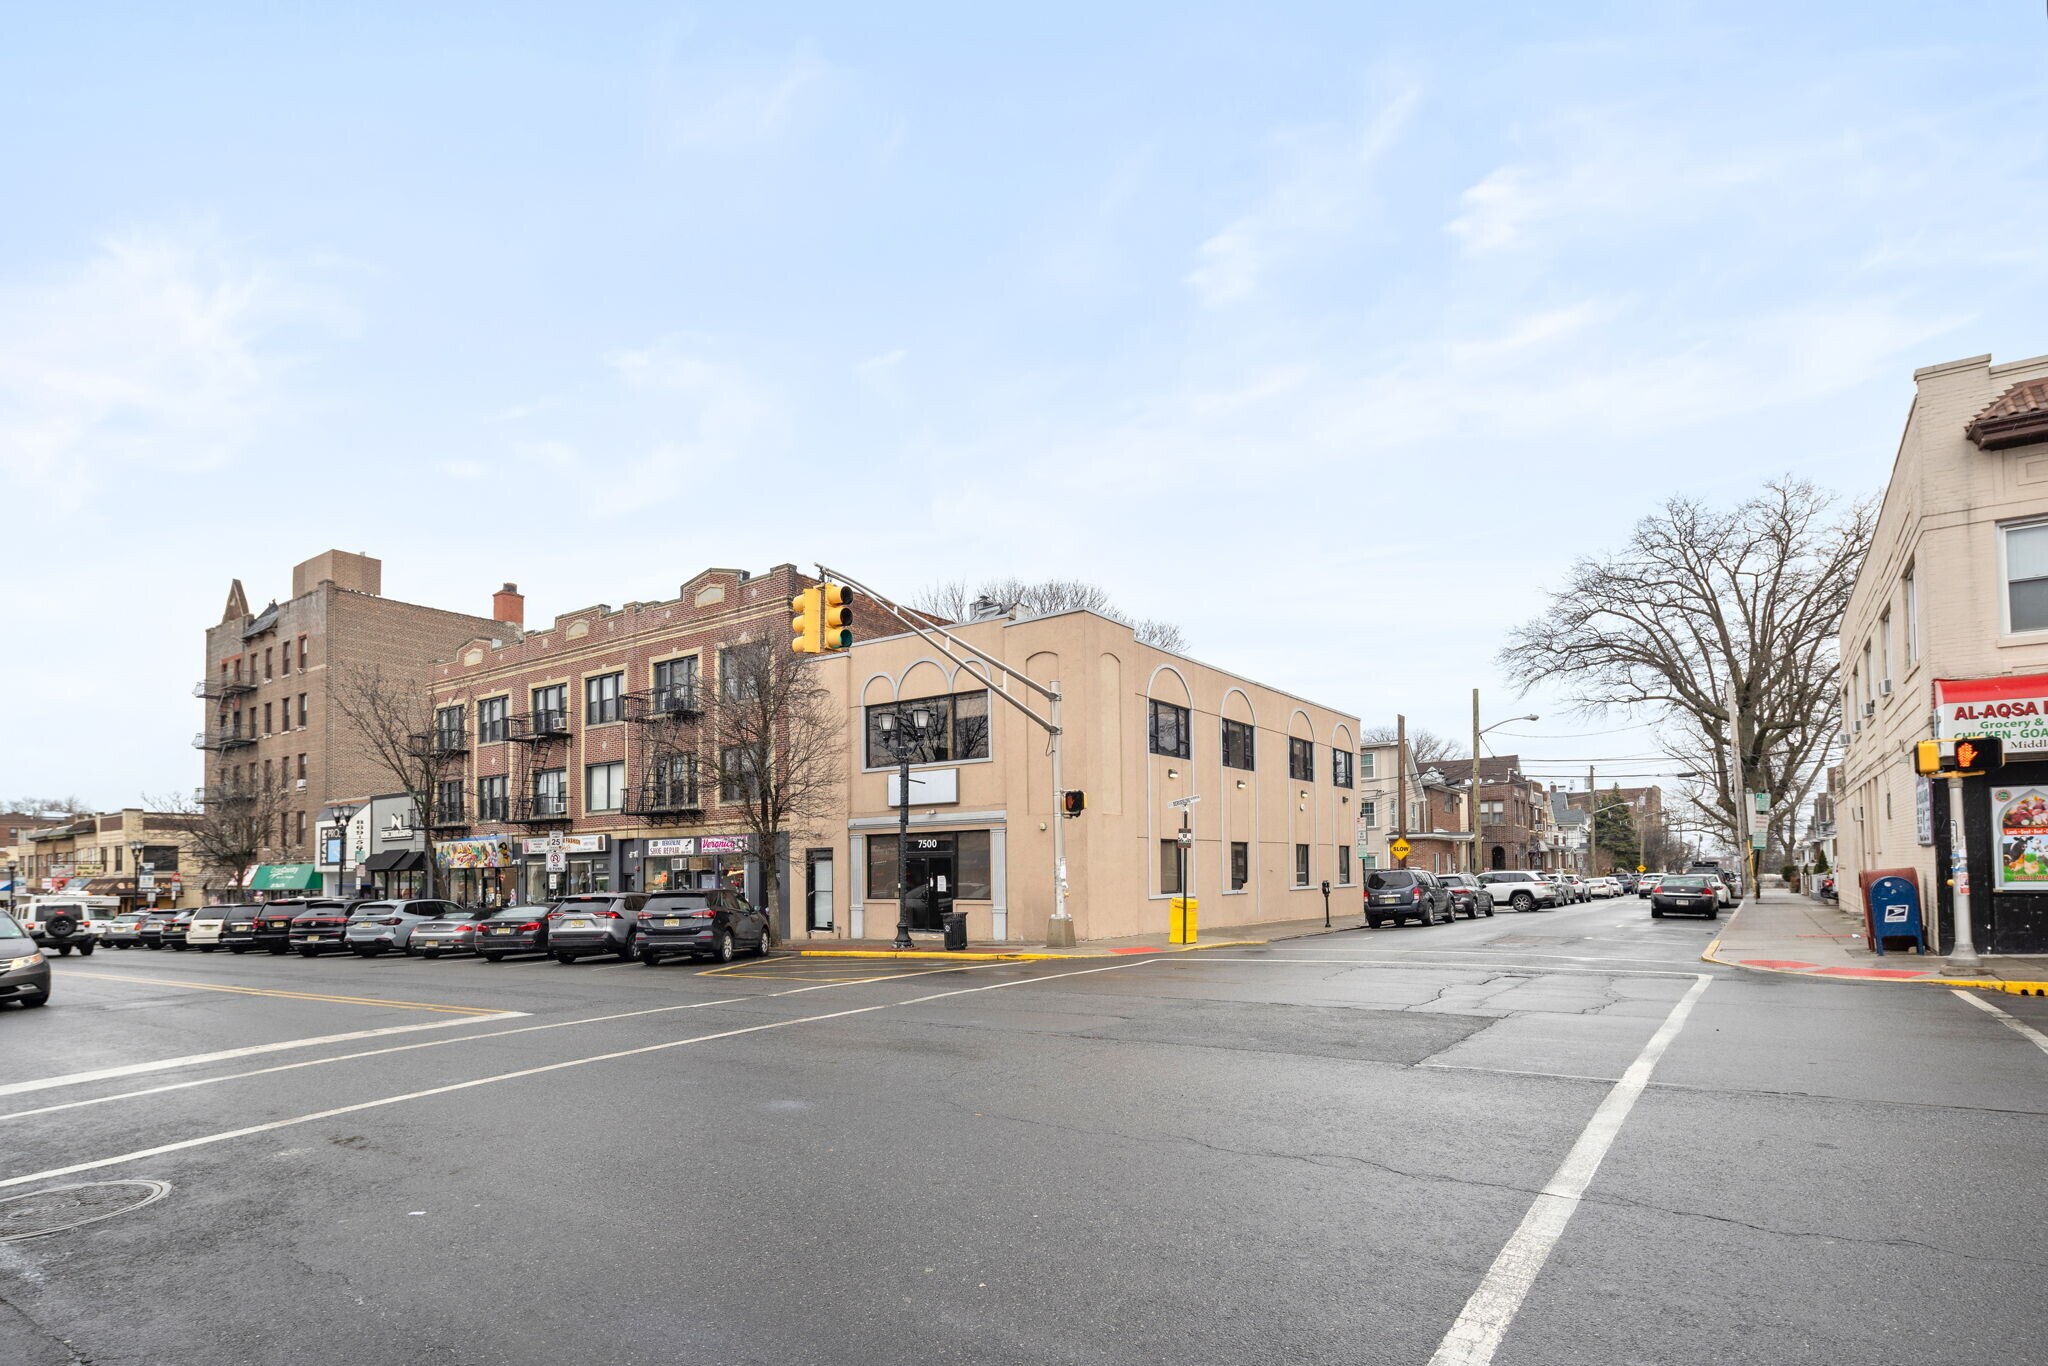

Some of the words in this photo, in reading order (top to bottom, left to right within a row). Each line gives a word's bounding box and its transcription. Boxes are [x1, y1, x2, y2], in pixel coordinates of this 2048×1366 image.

[1954, 702, 2039, 720] AL-AQSA
[1980, 719, 2031, 729] Grocery
[2034, 718, 2044, 726] &
[2010, 740, 2048, 749] Middl
[551, 838, 561, 846] 25
[702, 840, 736, 849] Veronica
[918, 839, 937, 848] 7500
[649, 847, 661, 855] SHOE
